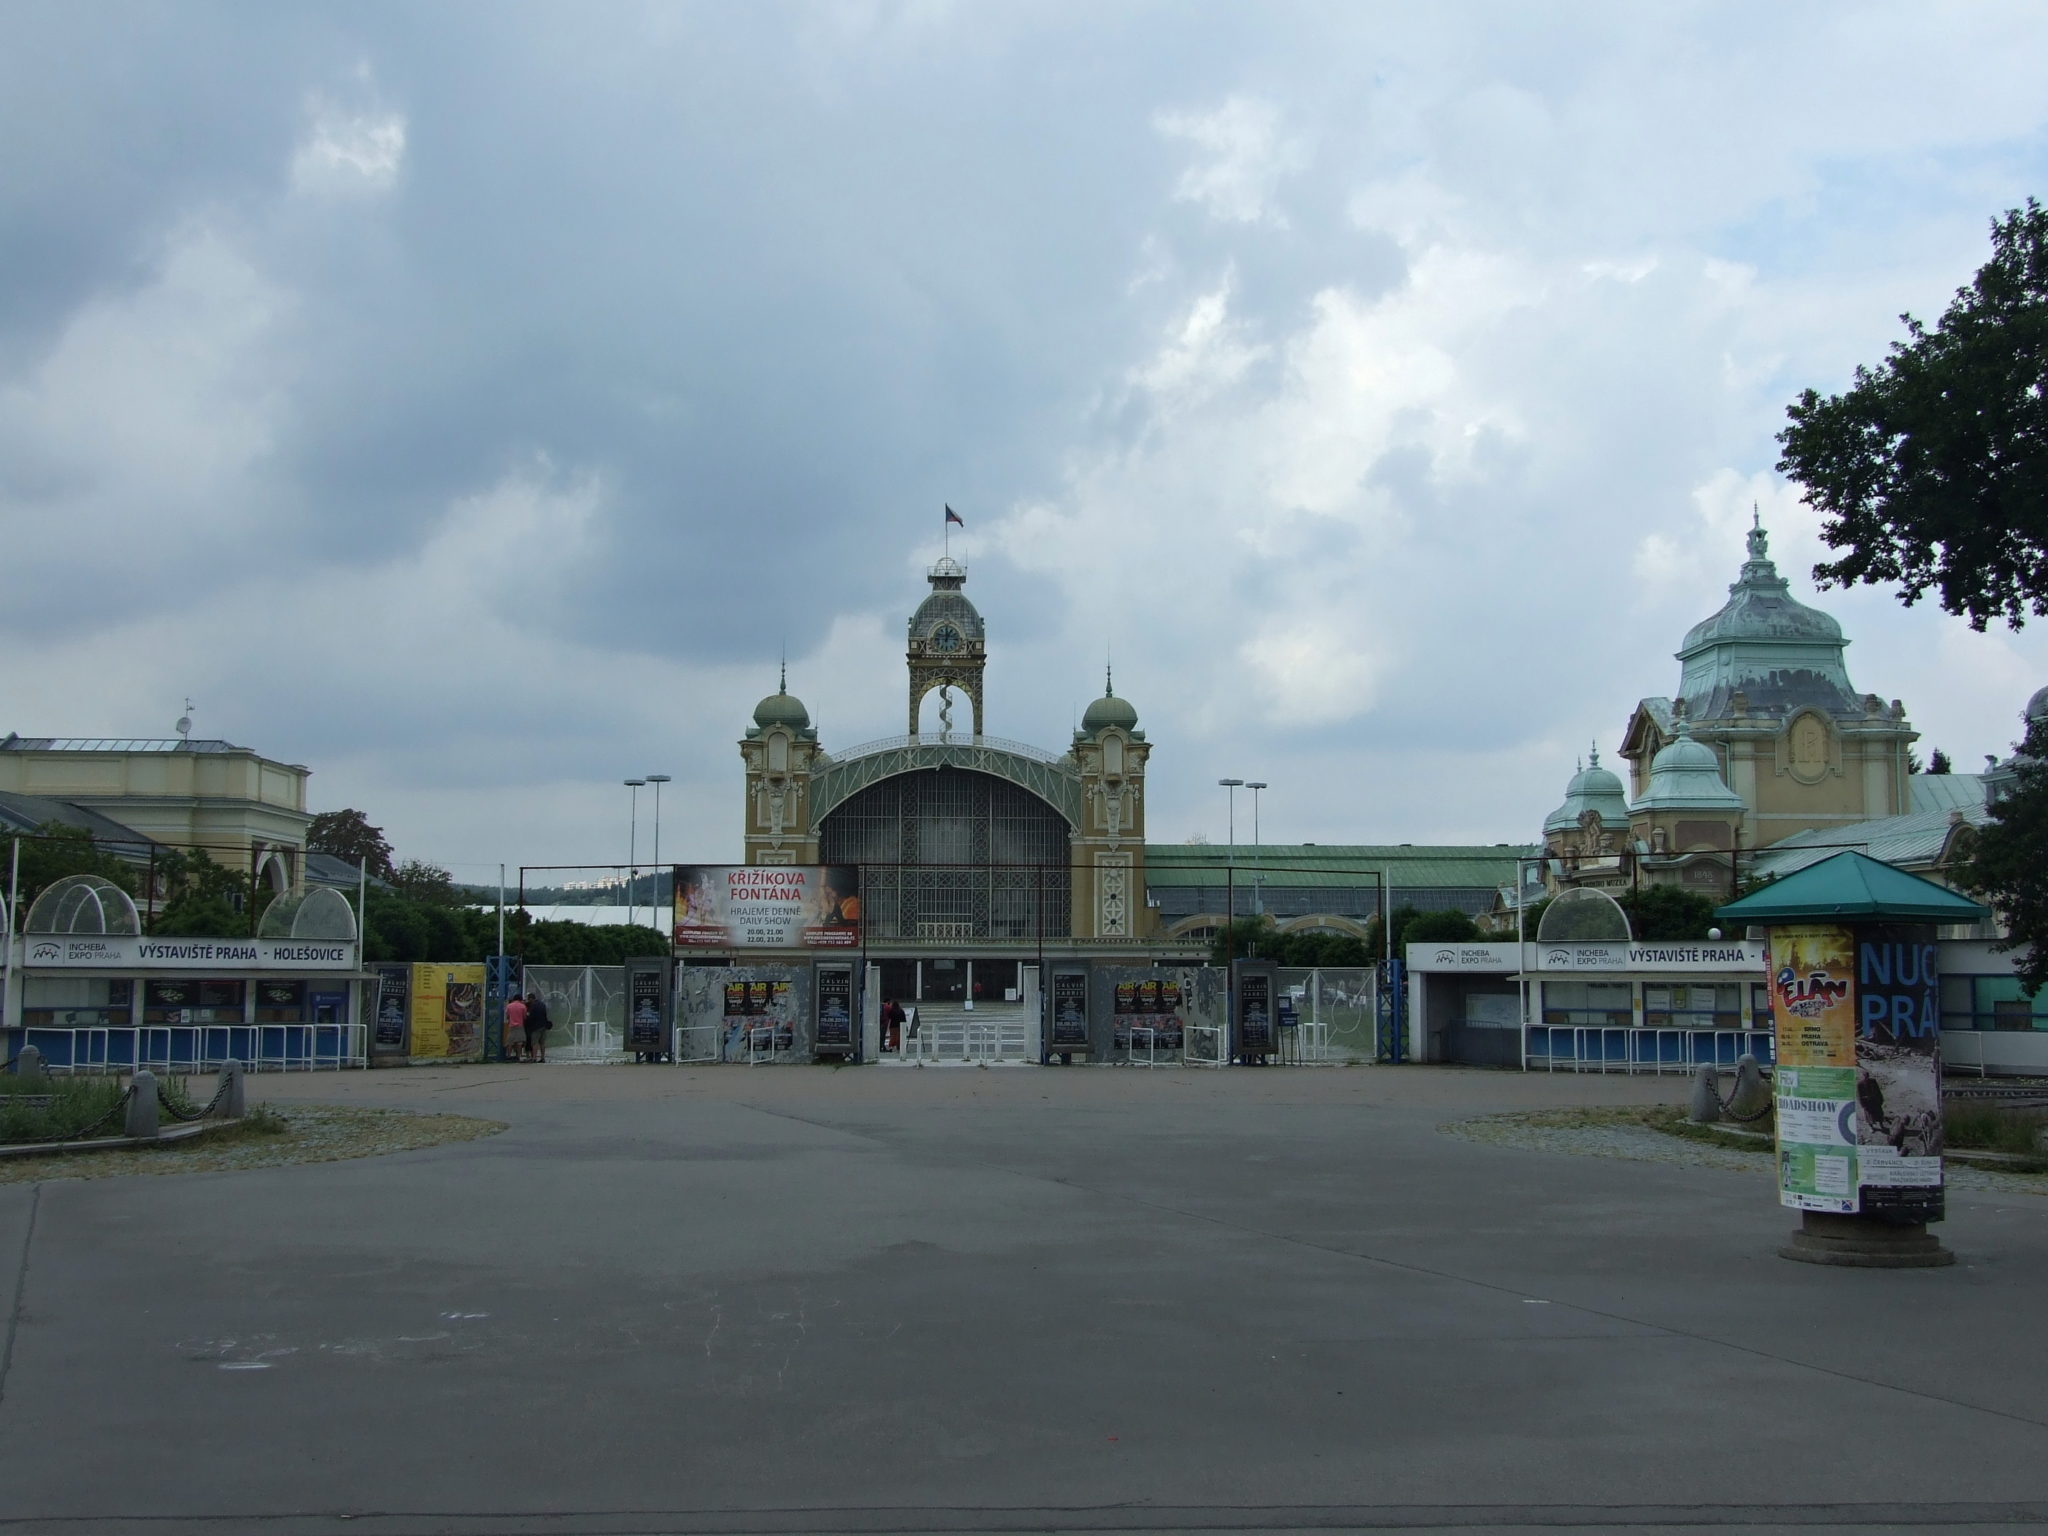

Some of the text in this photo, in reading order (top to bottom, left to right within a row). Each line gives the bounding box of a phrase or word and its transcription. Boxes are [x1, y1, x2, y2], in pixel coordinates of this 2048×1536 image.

[728, 869, 805, 885] KŘIŽÍKOVA
[730, 885, 801, 900] FONTÁNA
[771, 905, 801, 915] DENNĚ
[740, 917, 791, 925] DAILY SHOW
[69, 943, 106, 951] INCHEBA
[69, 952, 121, 960] EXPO PRAHA
[139, 943, 213, 960] VÝSTAVIŠTĚ
[216, 947, 257, 960] PRAHA
[274, 945, 344, 961] HOLEŠOVICE
[1461, 949, 1490, 957] INCHEBA
[1577, 949, 1608, 957] INCHEBA
[1629, 947, 1699, 962] VÝSTAVIŠTĚ
[1702, 949, 1744, 961] PRAHA
[1577, 957, 1597, 965] EXPO
[1778, 1098, 1838, 1113] ROADSHOW
